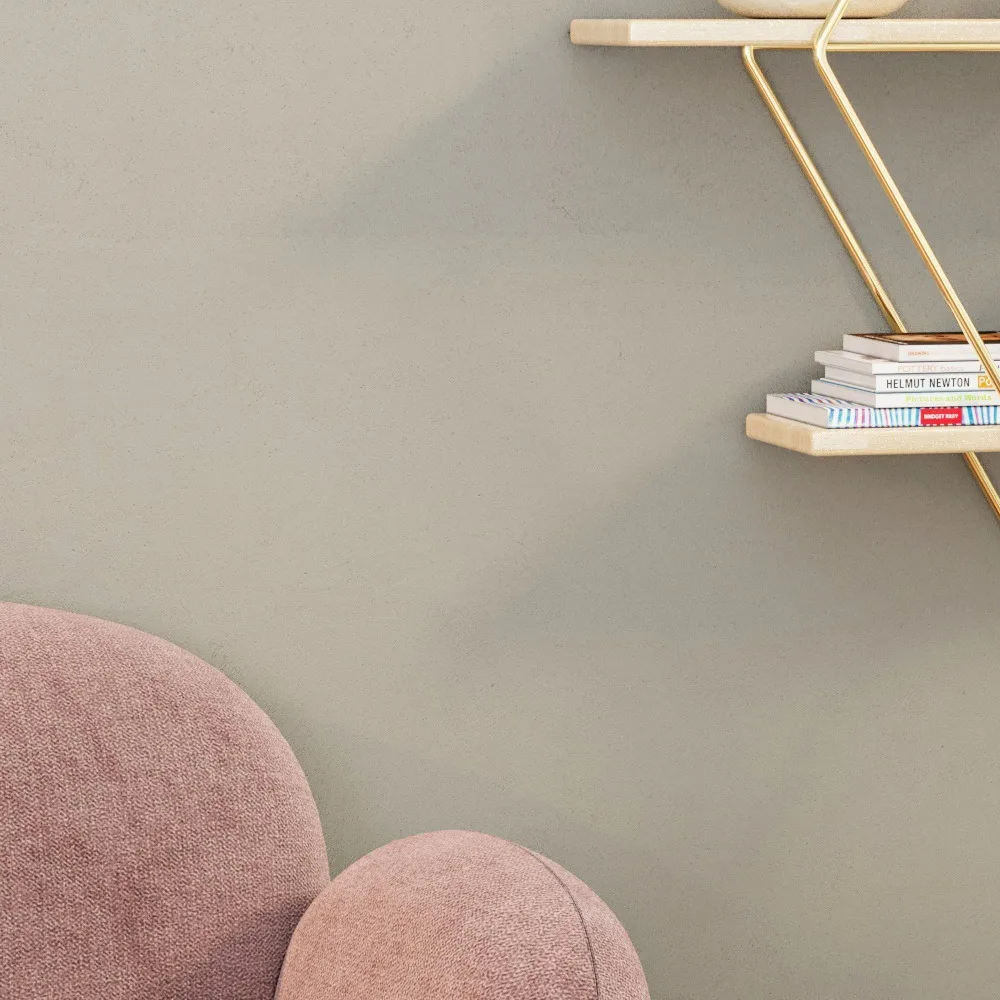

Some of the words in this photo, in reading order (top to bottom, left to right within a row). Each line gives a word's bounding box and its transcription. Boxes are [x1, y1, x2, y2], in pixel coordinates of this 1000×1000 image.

[897, 365, 937, 373] POTTERY
[886, 378, 926, 389] HELMUT
[929, 377, 970, 388] NEWTON
[946, 394, 962, 402] and
[964, 394, 992, 402] Words
